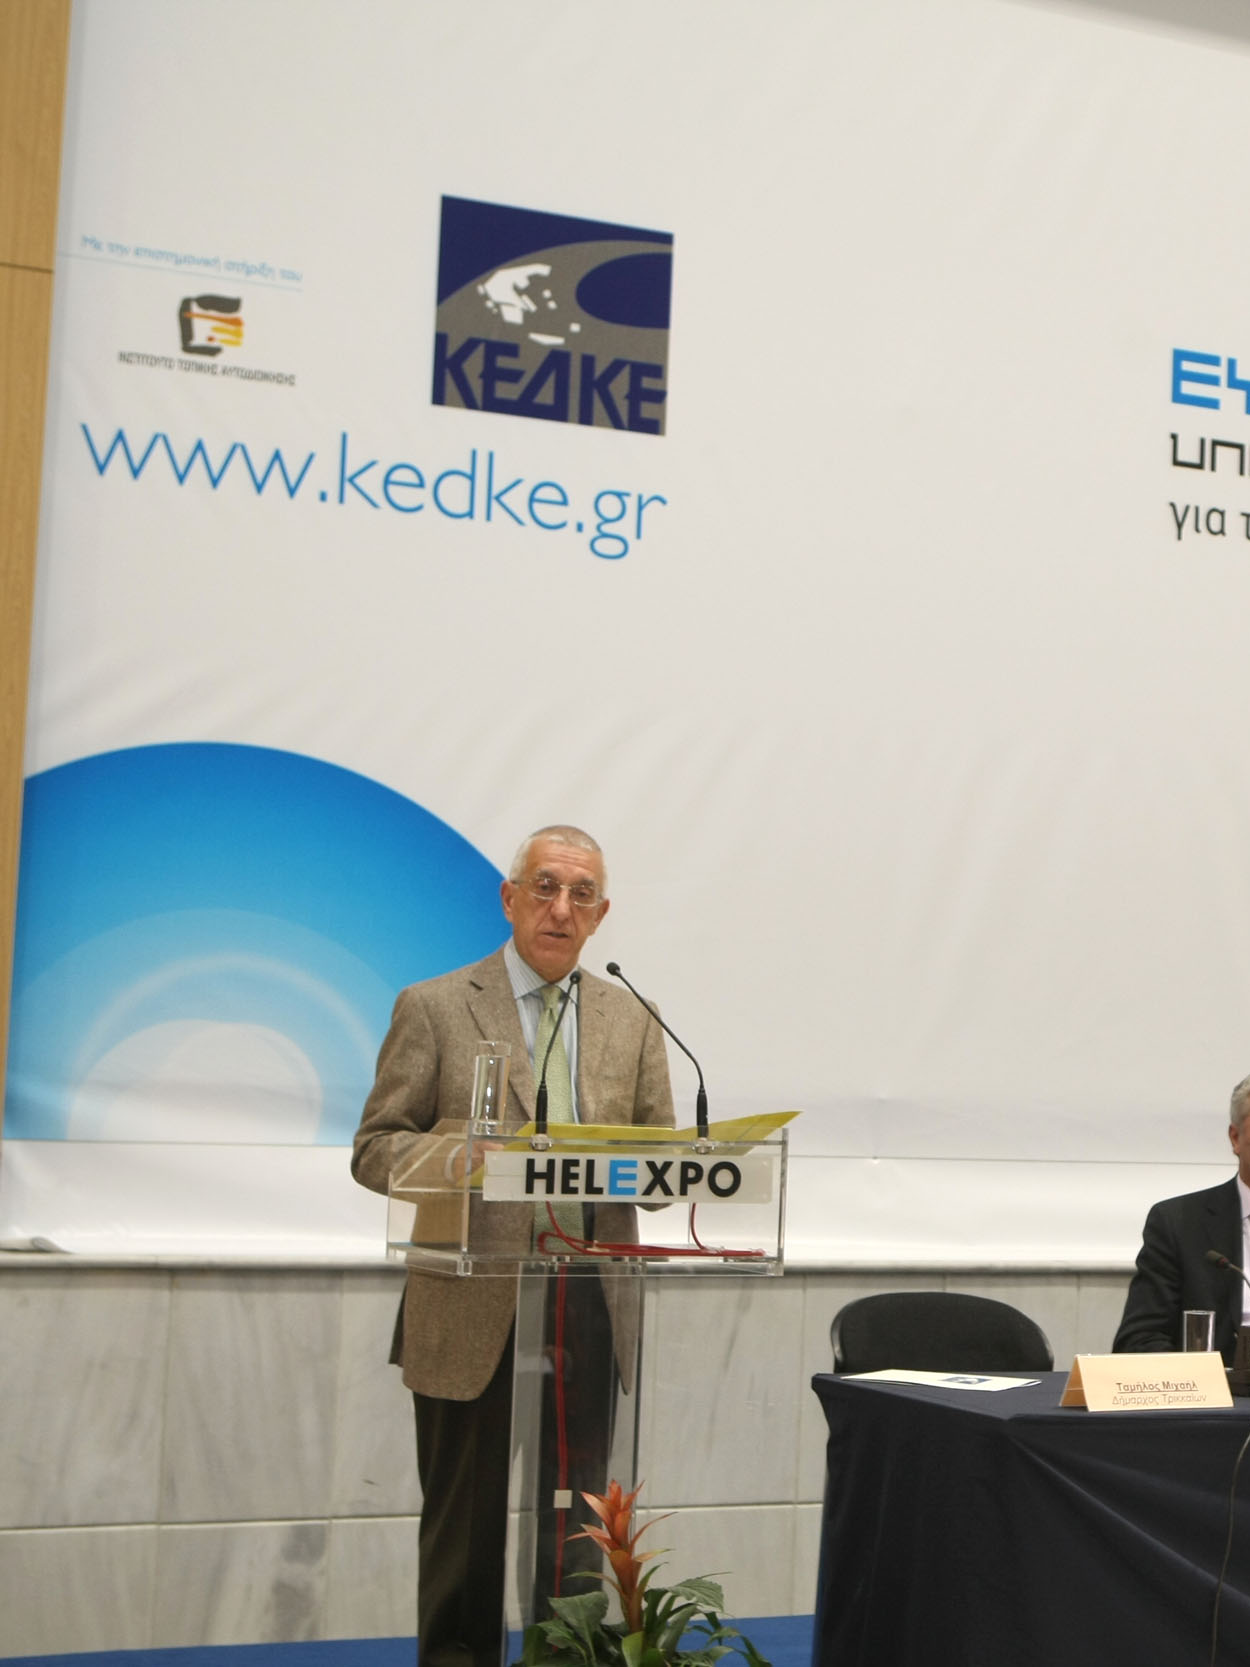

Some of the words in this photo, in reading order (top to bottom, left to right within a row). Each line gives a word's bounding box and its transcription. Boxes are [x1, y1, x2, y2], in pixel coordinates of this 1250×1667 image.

[81, 423, 668, 560] www.kedke.gr
[1169, 501, 1227, 541] για
[524, 1158, 742, 1198] HELEXPO
[1112, 1395, 1160, 1406] Δήμαρχος
[1115, 1381, 1161, 1393] Ταμήλος
[1162, 1380, 1198, 1392] Μιχαήλ
